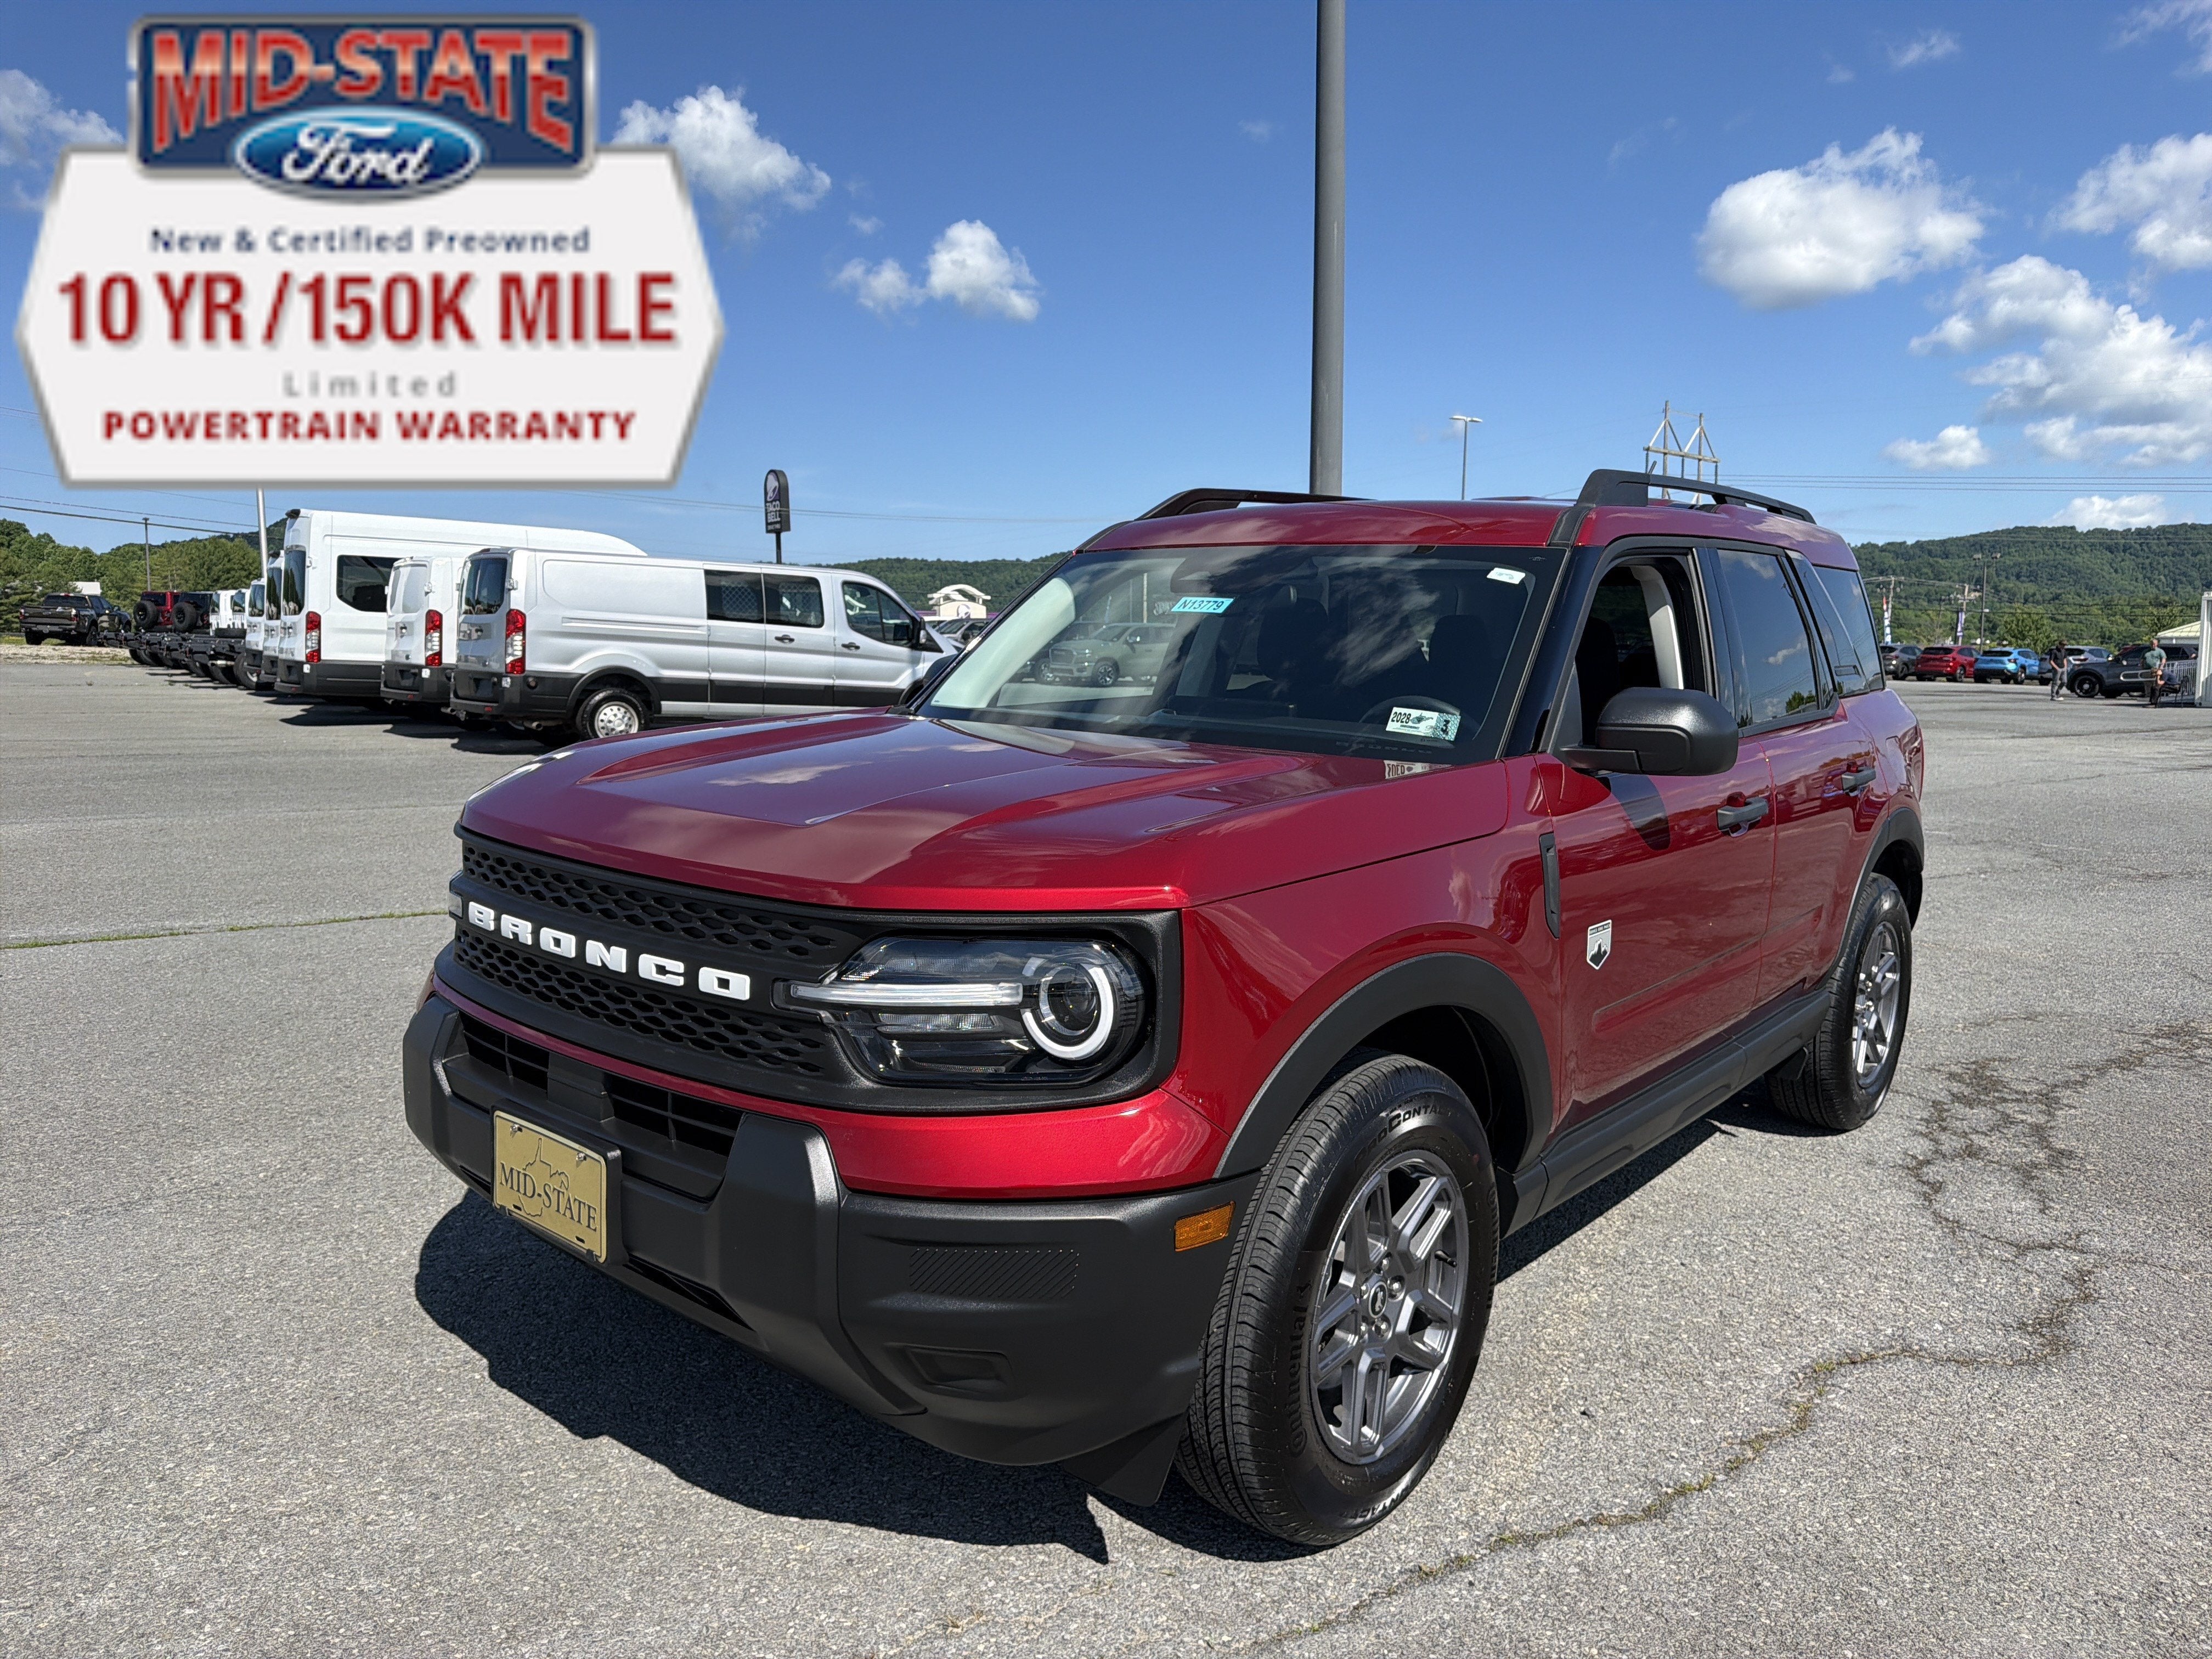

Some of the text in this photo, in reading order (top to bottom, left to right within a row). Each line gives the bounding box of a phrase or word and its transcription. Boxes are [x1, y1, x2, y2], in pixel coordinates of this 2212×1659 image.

[766, 500, 780, 512] TACO
[768, 511, 781, 523] BELL
[1178, 599, 1224, 611] N13779
[1391, 711, 1412, 724] 2028
[1441, 719, 1451, 736] 3
[468, 901, 751, 1001] BRONCO
[500, 1161, 597, 1232] MID-STATE
